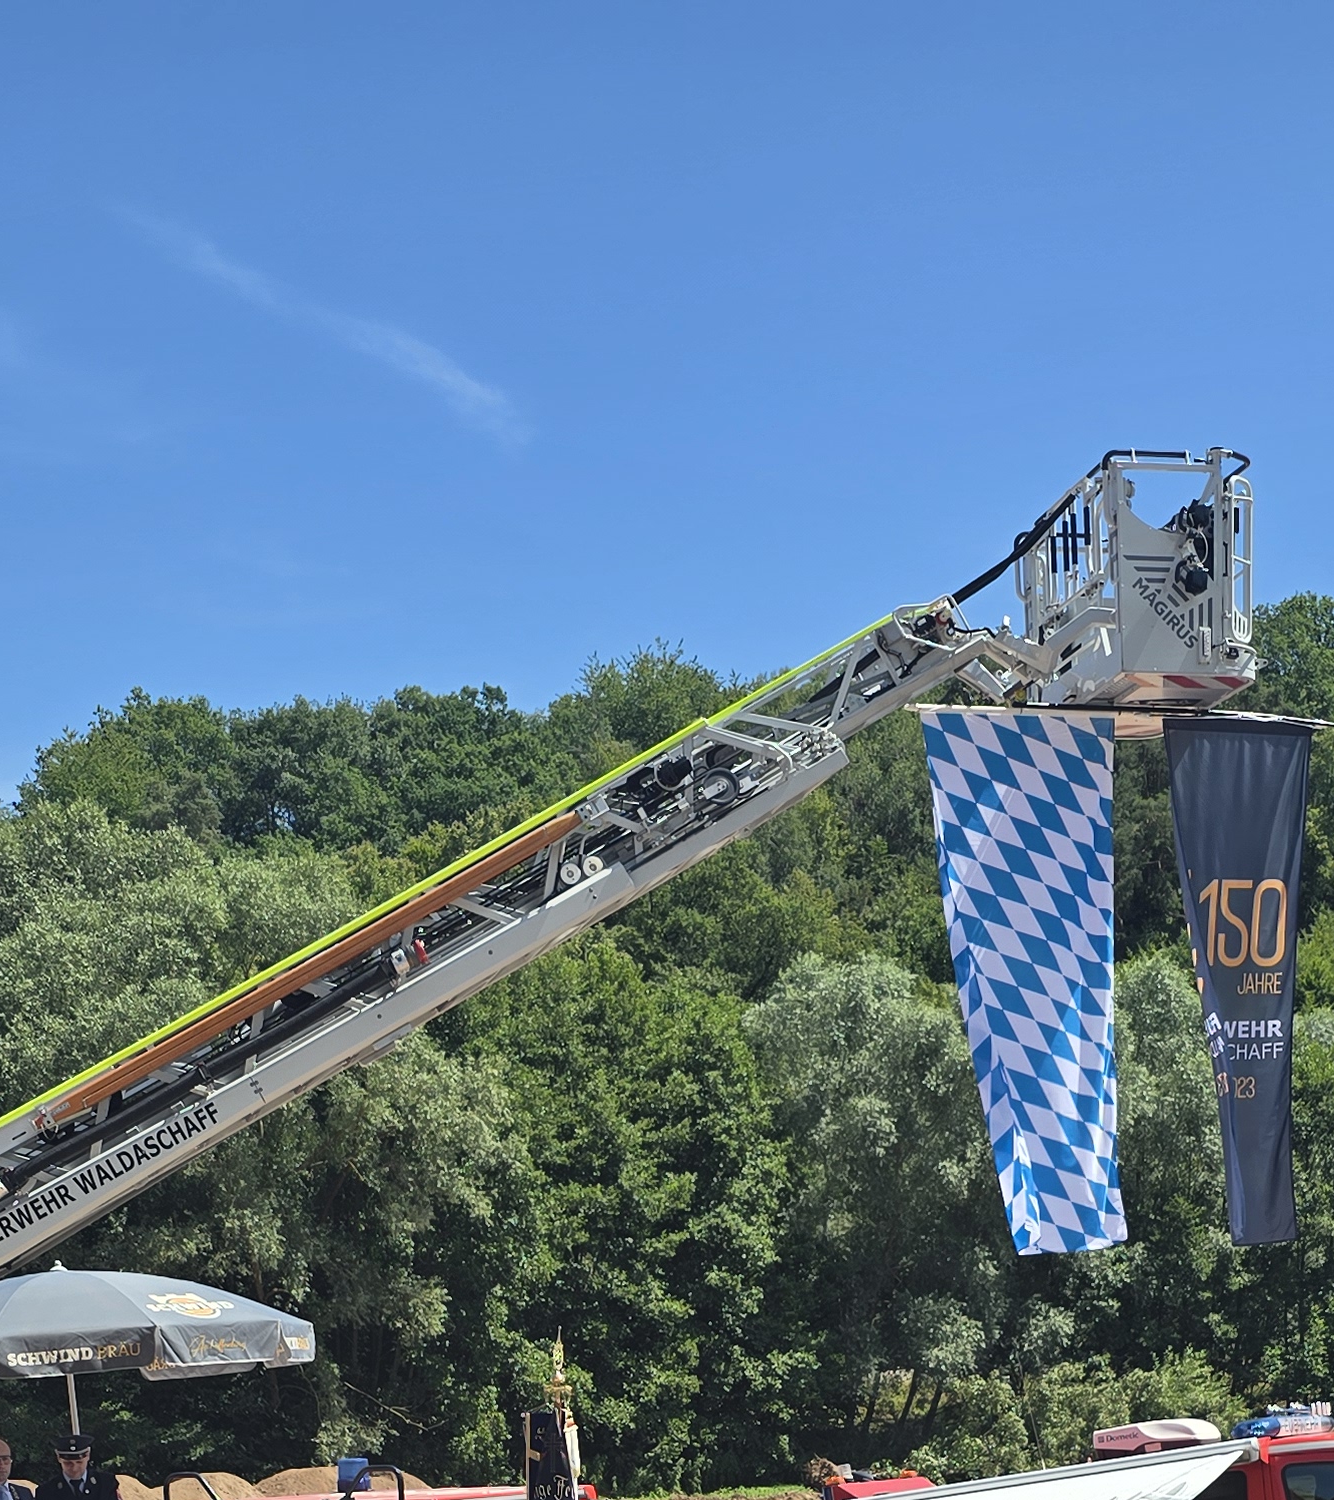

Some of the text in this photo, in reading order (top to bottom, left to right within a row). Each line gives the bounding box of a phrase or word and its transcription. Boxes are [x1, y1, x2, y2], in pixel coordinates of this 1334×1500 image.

[1132, 577, 1199, 649] MAGIRUS
[1199, 879, 1287, 968] 150
[1237, 972, 1282, 995] JAHRE
[73, 1102, 221, 1199] WALDASCHAFF
[7, 1341, 141, 1367] SCHWIND BRÄU
[1106, 1431, 1139, 1442] Dometic
